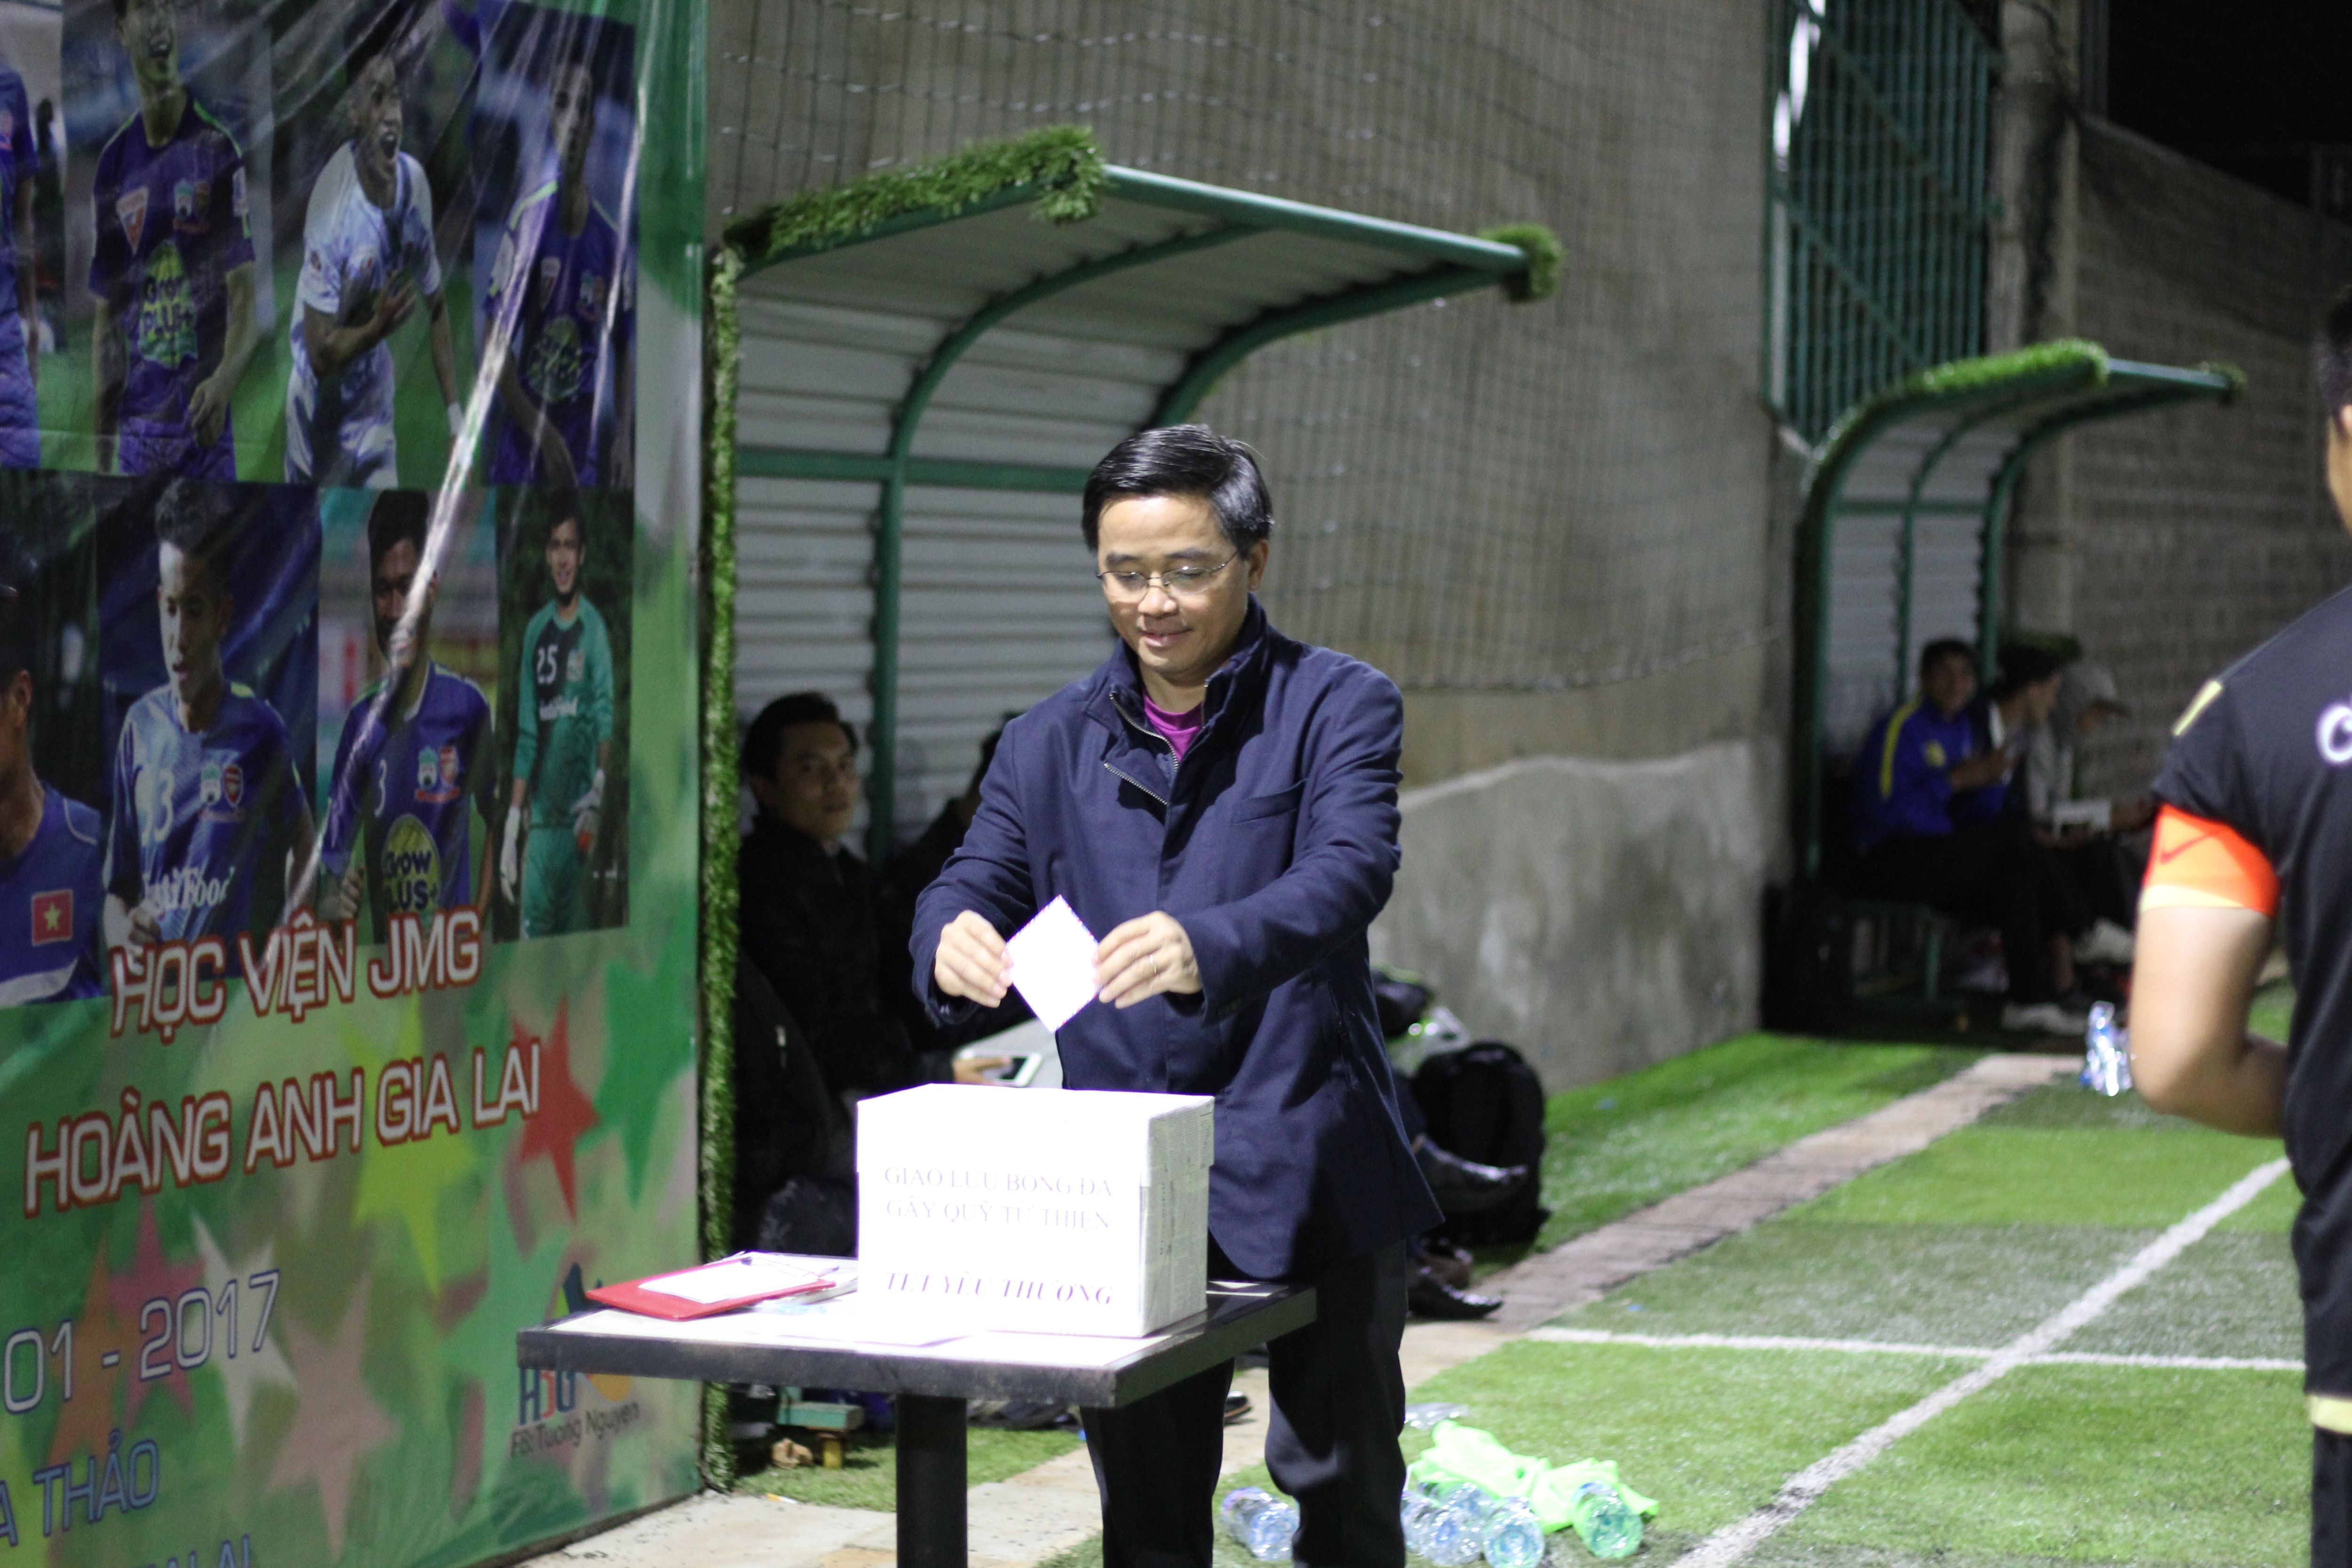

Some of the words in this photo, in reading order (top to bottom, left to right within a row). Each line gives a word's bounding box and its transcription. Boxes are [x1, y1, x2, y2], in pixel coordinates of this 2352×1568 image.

[535, 643, 558, 684] 25
[110, 939, 227, 1044] HỌC
[237, 912, 356, 1024] VIỆN
[368, 904, 482, 999] JMG
[23, 1085, 230, 1219] HOÀNG
[243, 1066, 365, 1172] ANH
[375, 1051, 459, 1147] GIA
[472, 1036, 542, 1128] LAI
[884, 1166, 943, 1186] GIAO
[886, 1194, 936, 1218] GÂY
[943, 1199, 993, 1223] QUỸ
[3, 1318, 73, 1413] 01
[102, 1350, 120, 1368] -
[140, 1268, 281, 1382] 2017
[32, 1428, 160, 1539] THẢO
